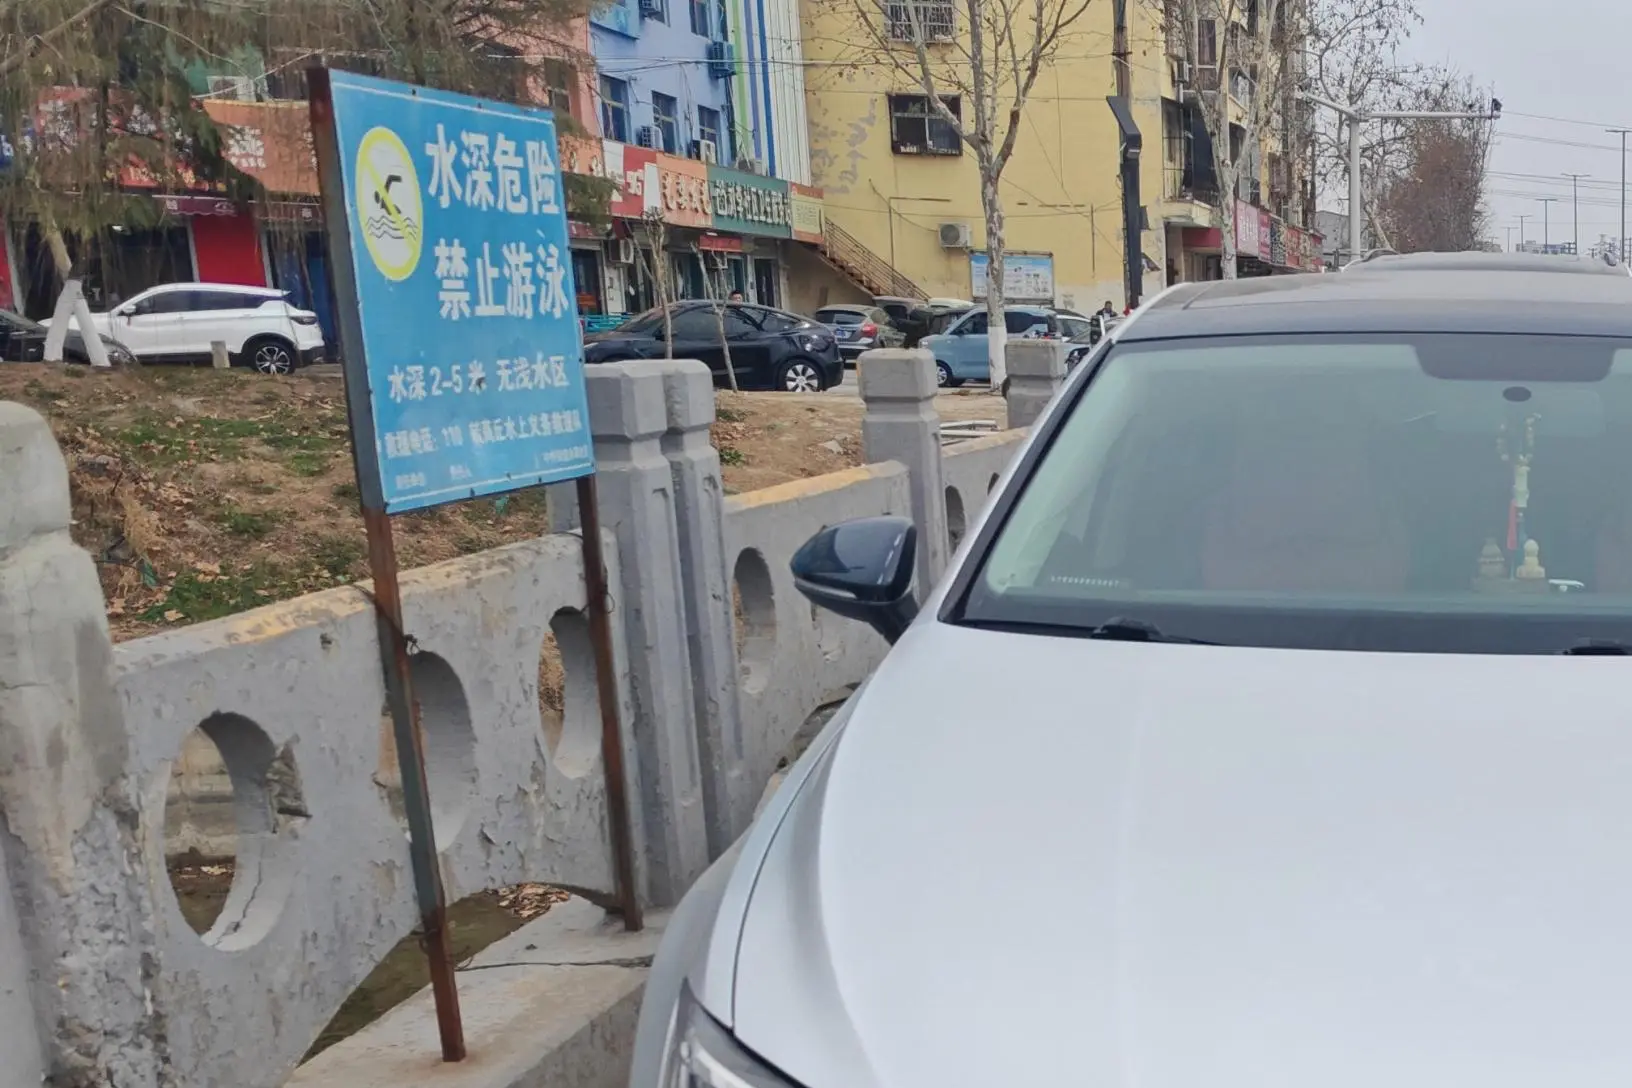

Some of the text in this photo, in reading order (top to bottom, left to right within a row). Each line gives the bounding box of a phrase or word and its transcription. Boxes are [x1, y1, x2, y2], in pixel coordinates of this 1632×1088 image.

[424, 122, 560, 215] 水深危险
[434, 228, 569, 321] 禁止游泳
[496, 352, 570, 392] 无浅水区
